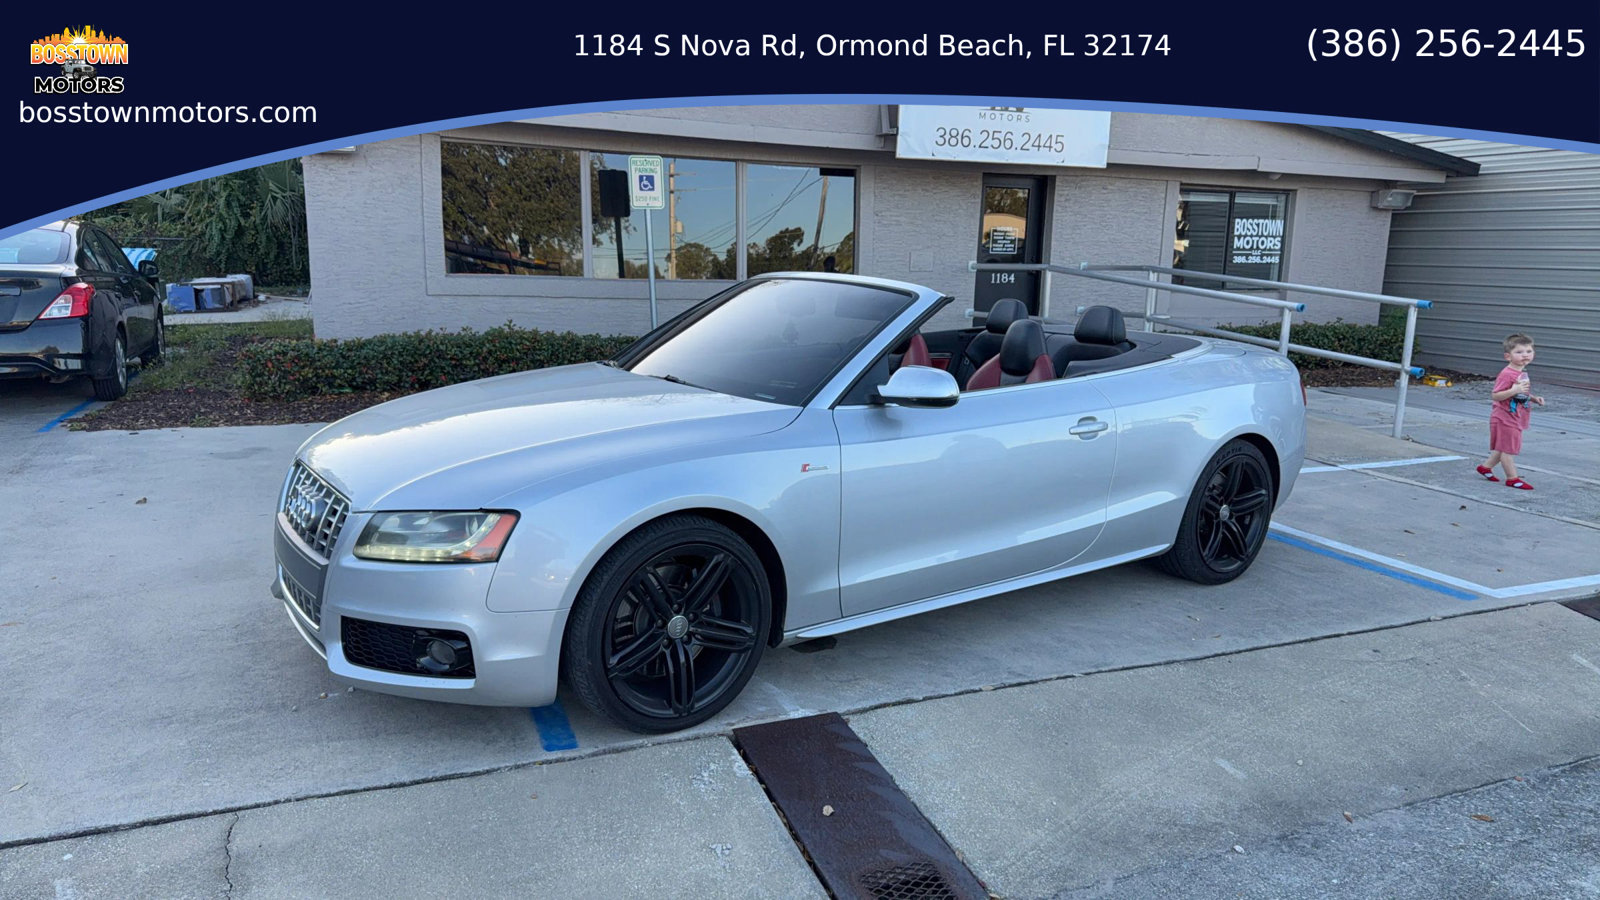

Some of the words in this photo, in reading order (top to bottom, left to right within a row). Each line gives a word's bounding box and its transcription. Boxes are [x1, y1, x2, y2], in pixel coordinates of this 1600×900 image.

[978, 111, 1031, 123] MOTORS
[935, 126, 1065, 153] 386.256.2445
[1234, 218, 1284, 236] BOSSTOWN
[1233, 236, 1281, 249] MOTORS
[1232, 255, 1280, 264] 386.256.2445
[991, 272, 1015, 284] 1184
